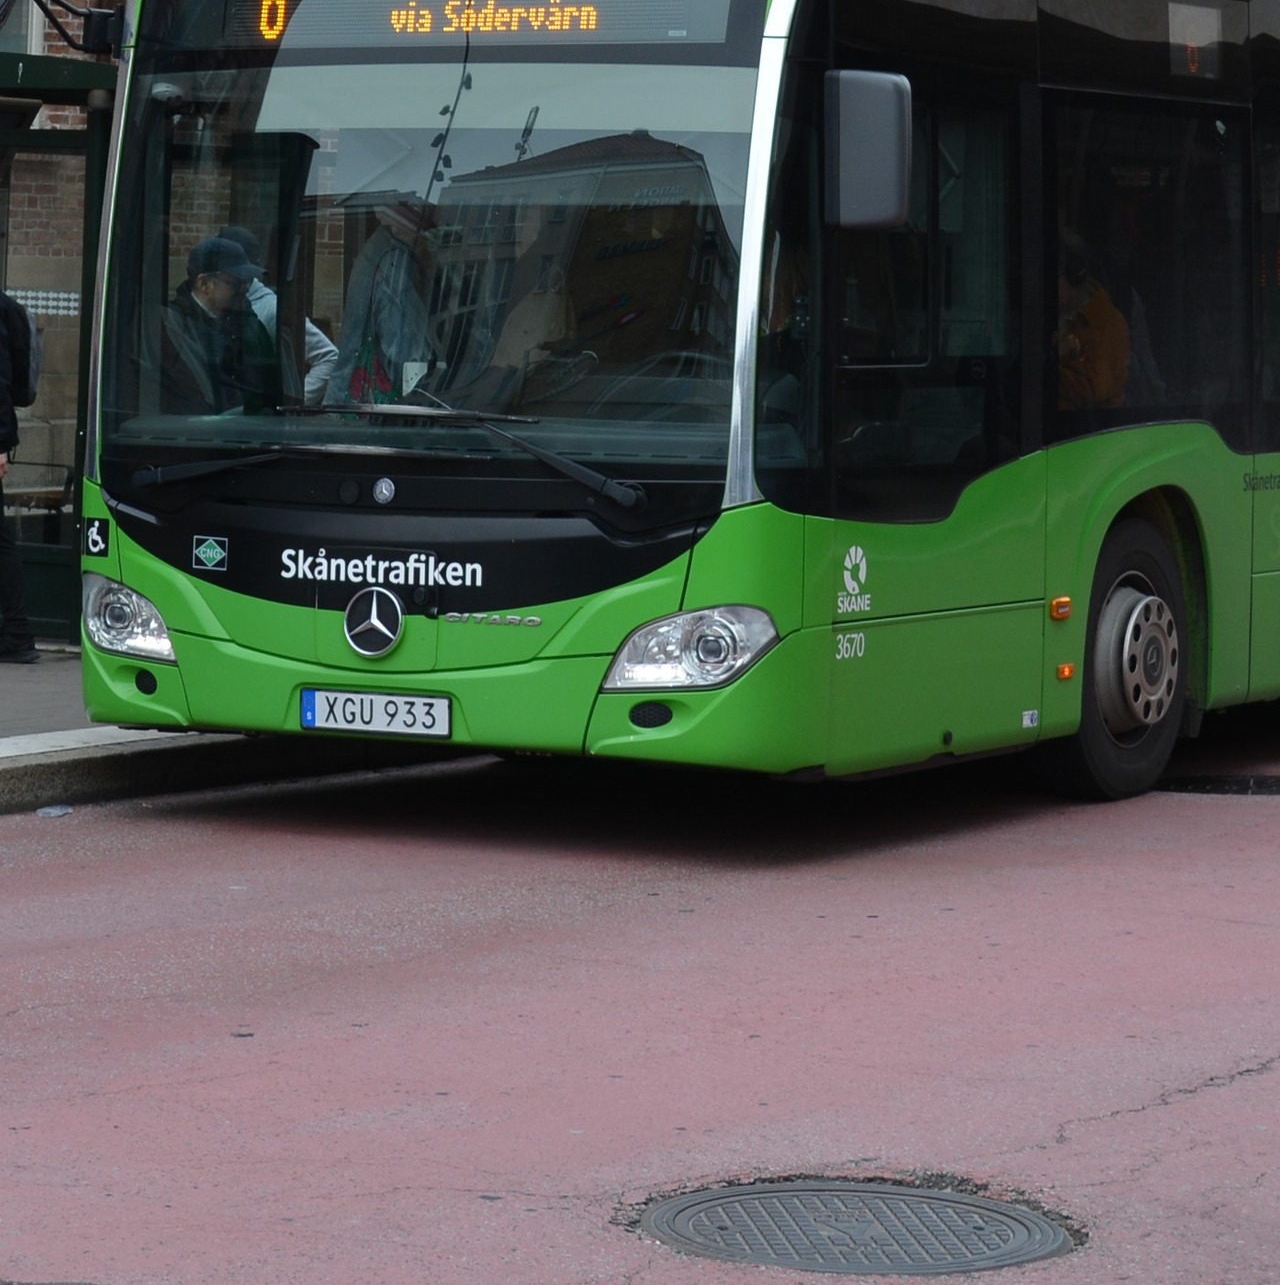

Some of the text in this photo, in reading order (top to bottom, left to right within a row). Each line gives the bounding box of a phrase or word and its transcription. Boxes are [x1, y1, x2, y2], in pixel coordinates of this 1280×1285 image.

[390, 1, 434, 35] via
[200, 547, 221, 559] CNG
[280, 546, 484, 588] Skånetrafiken
[443, 611, 542, 628] CITARO
[835, 632, 865, 661] 3670
[324, 695, 437, 730] XGU 933
